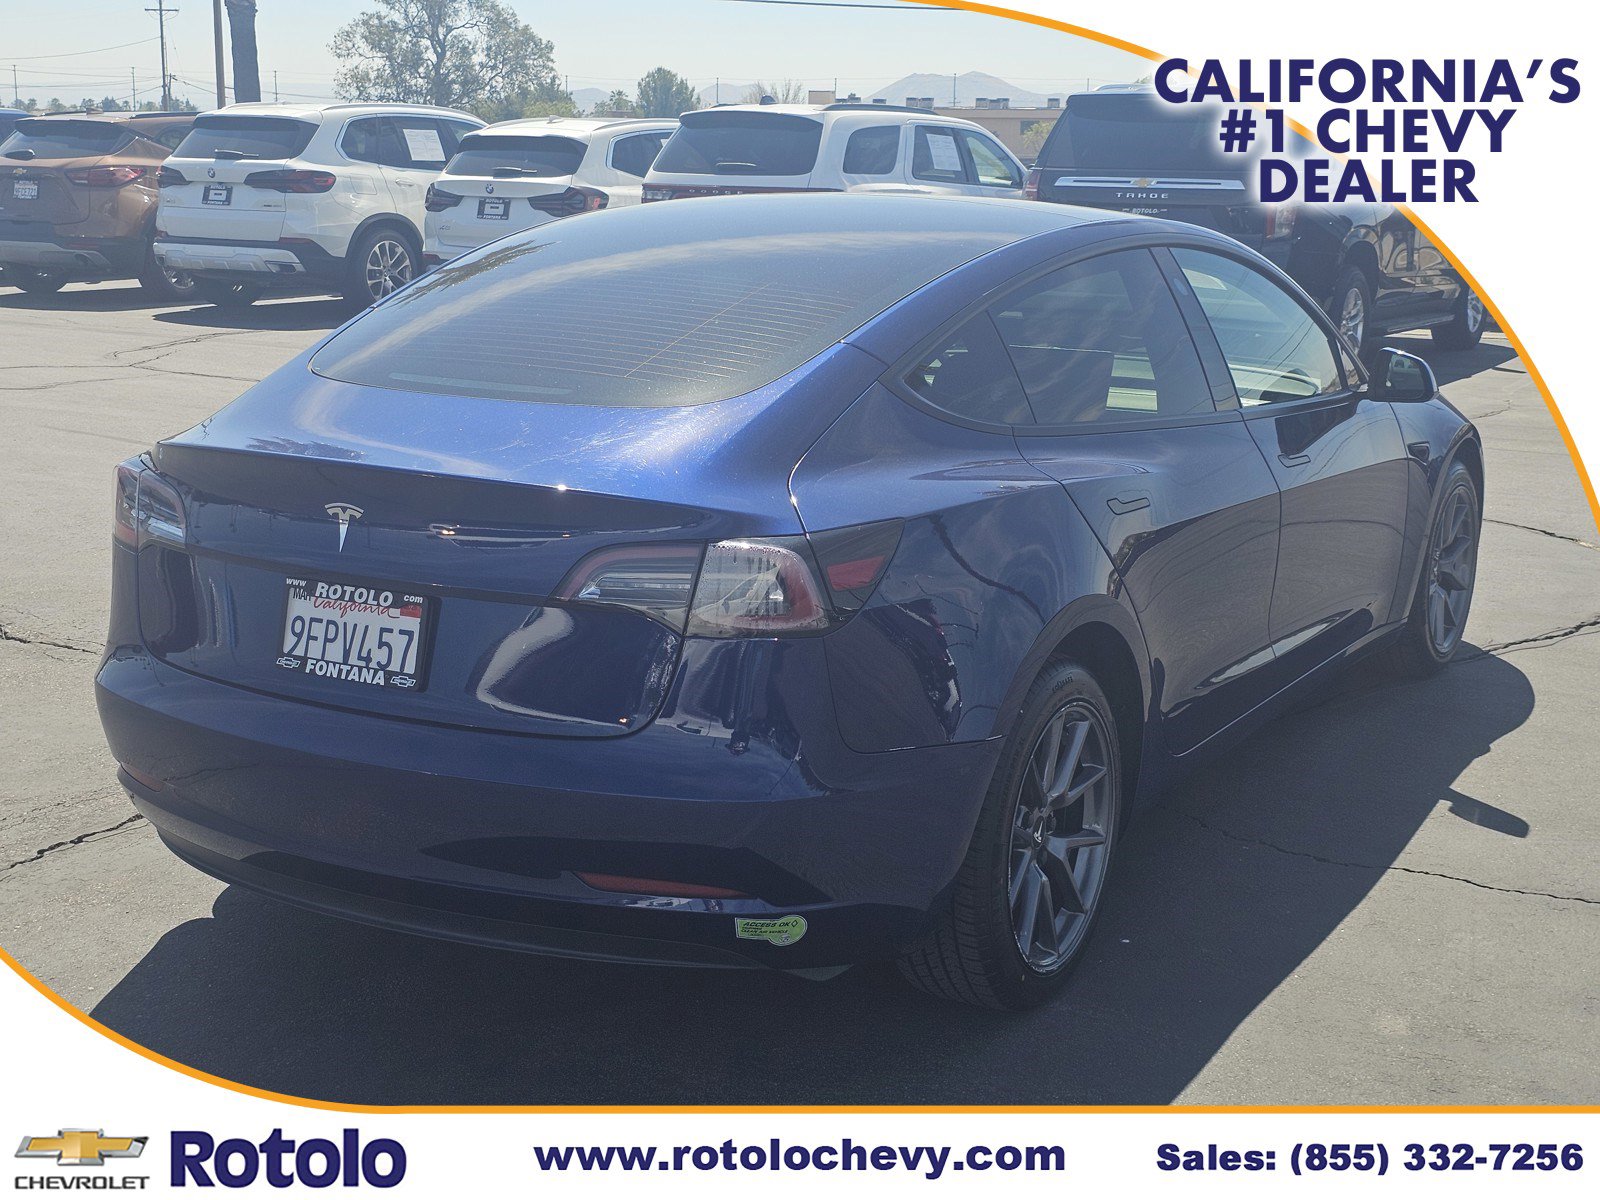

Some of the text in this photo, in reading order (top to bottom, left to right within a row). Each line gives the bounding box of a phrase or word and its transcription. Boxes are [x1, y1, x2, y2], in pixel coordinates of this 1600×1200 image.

[286, 578, 423, 607] www ROTOLO com
[287, 615, 415, 673] 9FPV457
[305, 658, 385, 686] FONTANA
